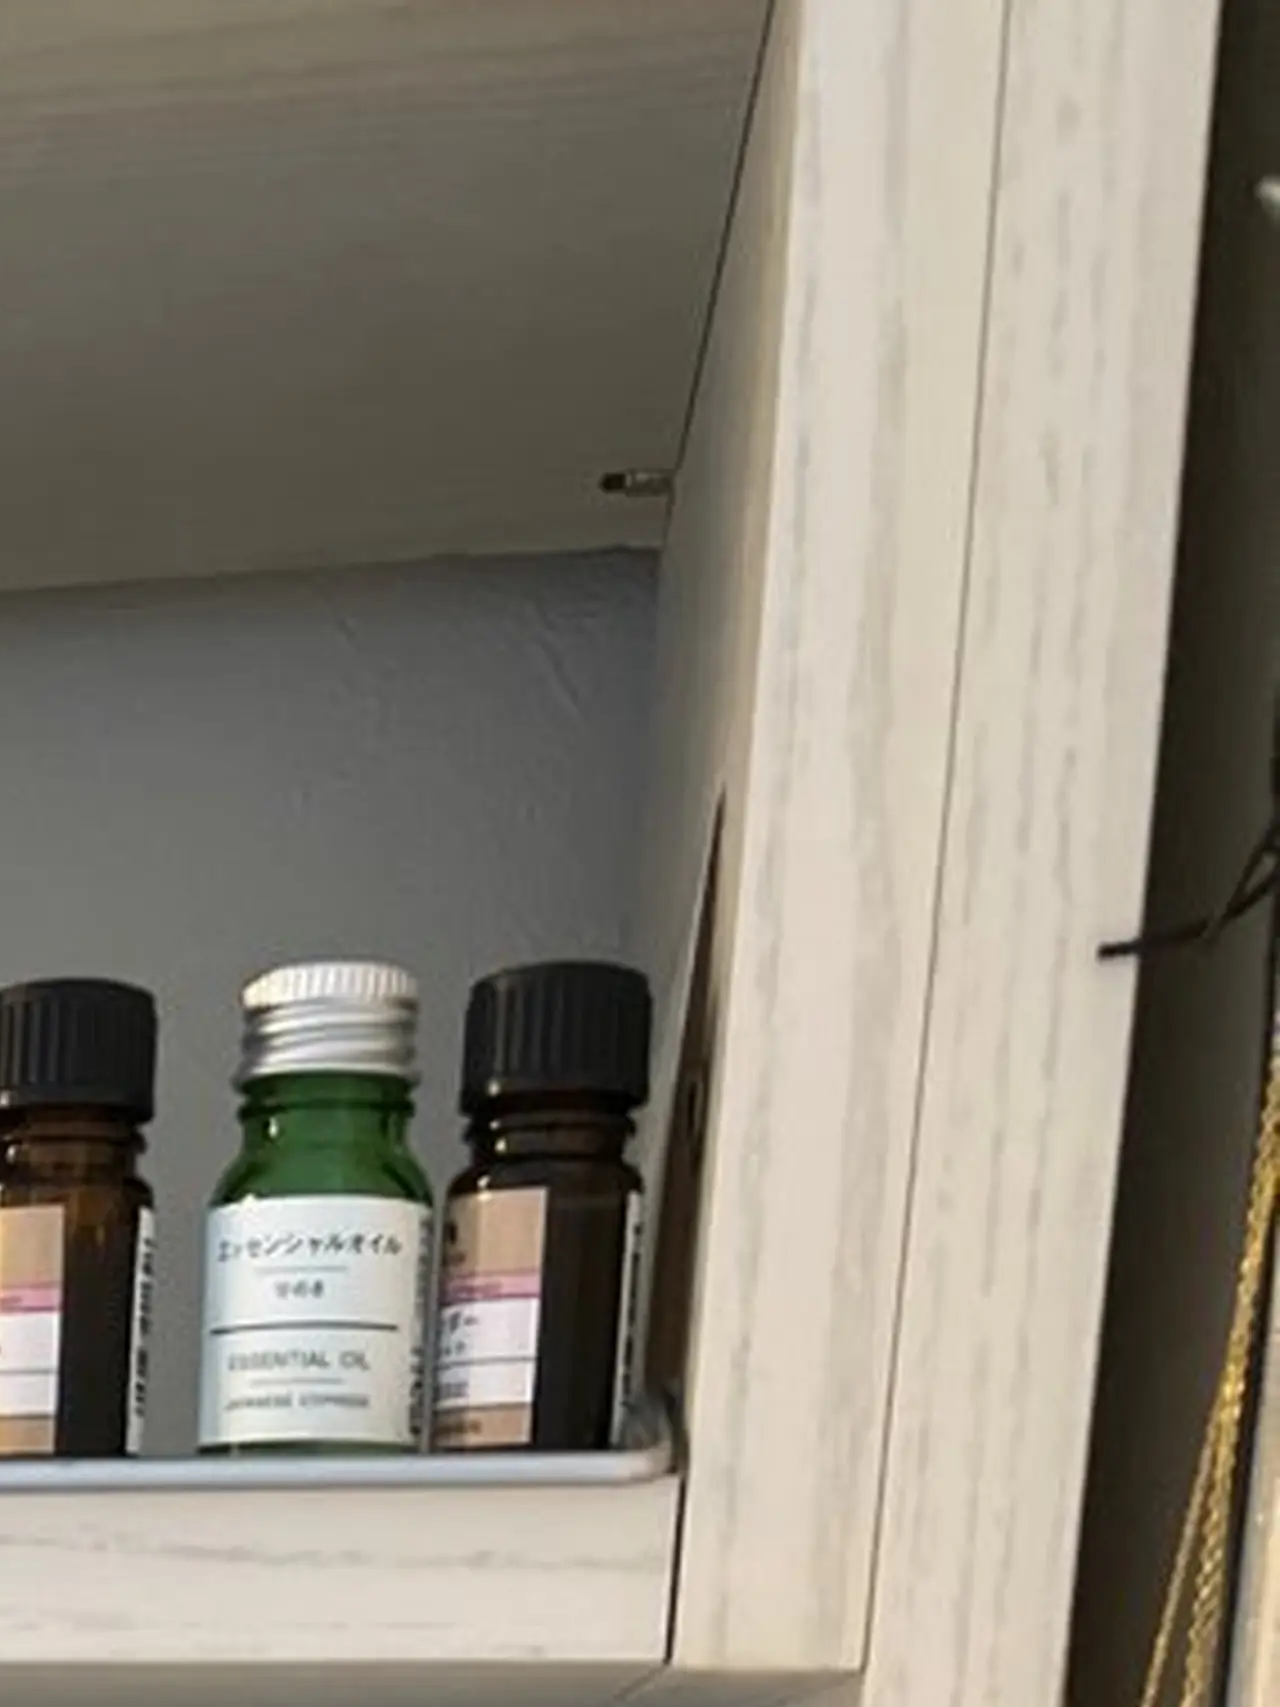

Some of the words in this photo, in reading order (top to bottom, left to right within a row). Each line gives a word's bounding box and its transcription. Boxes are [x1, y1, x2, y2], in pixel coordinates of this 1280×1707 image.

[218, 1233, 402, 1262] エッセンシャルオイル
[228, 1350, 330, 1371] ESSENTIAL
